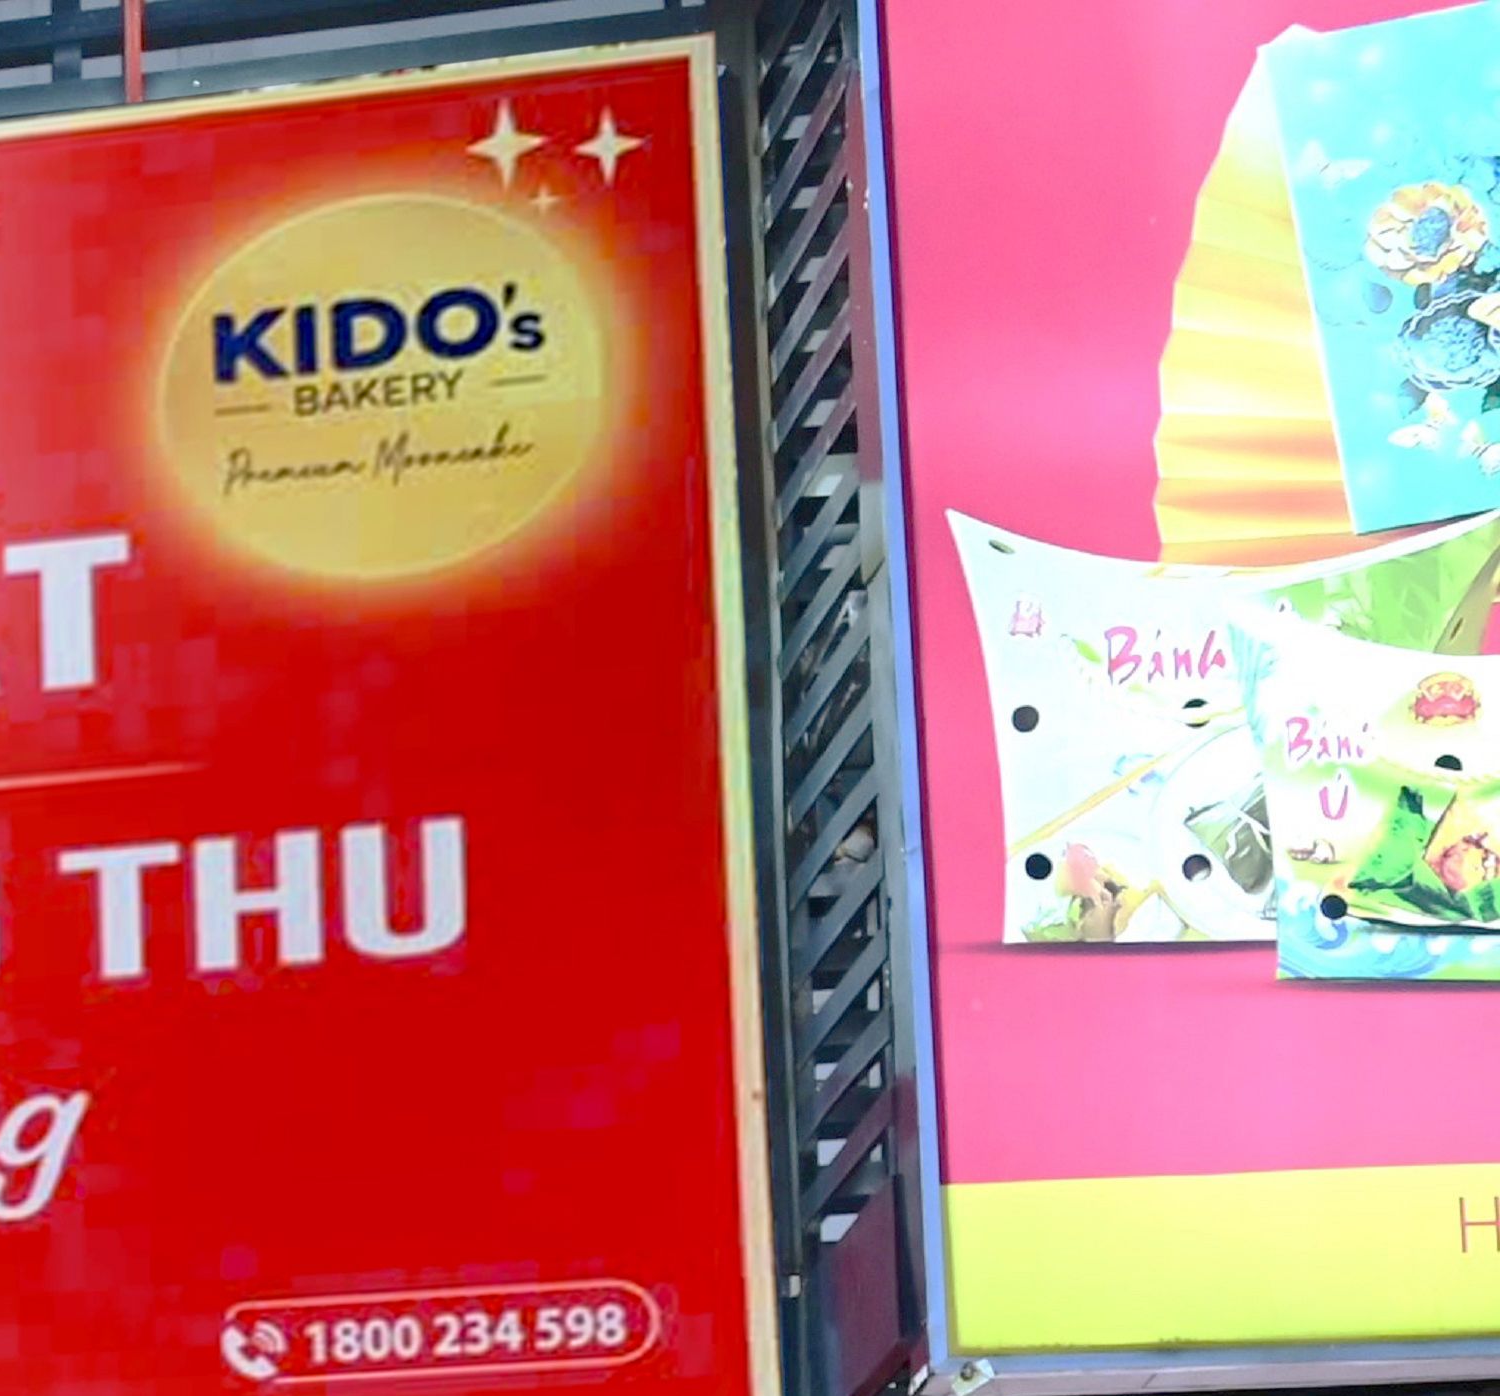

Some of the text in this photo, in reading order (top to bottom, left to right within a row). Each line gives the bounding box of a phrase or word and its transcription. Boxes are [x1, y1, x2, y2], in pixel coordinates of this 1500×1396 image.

[211, 282, 546, 385] KIDO's
[293, 370, 465, 417] BAKERY
[61, 813, 471, 982] THU
[303, 1301, 627, 1364] 1800 234 598
